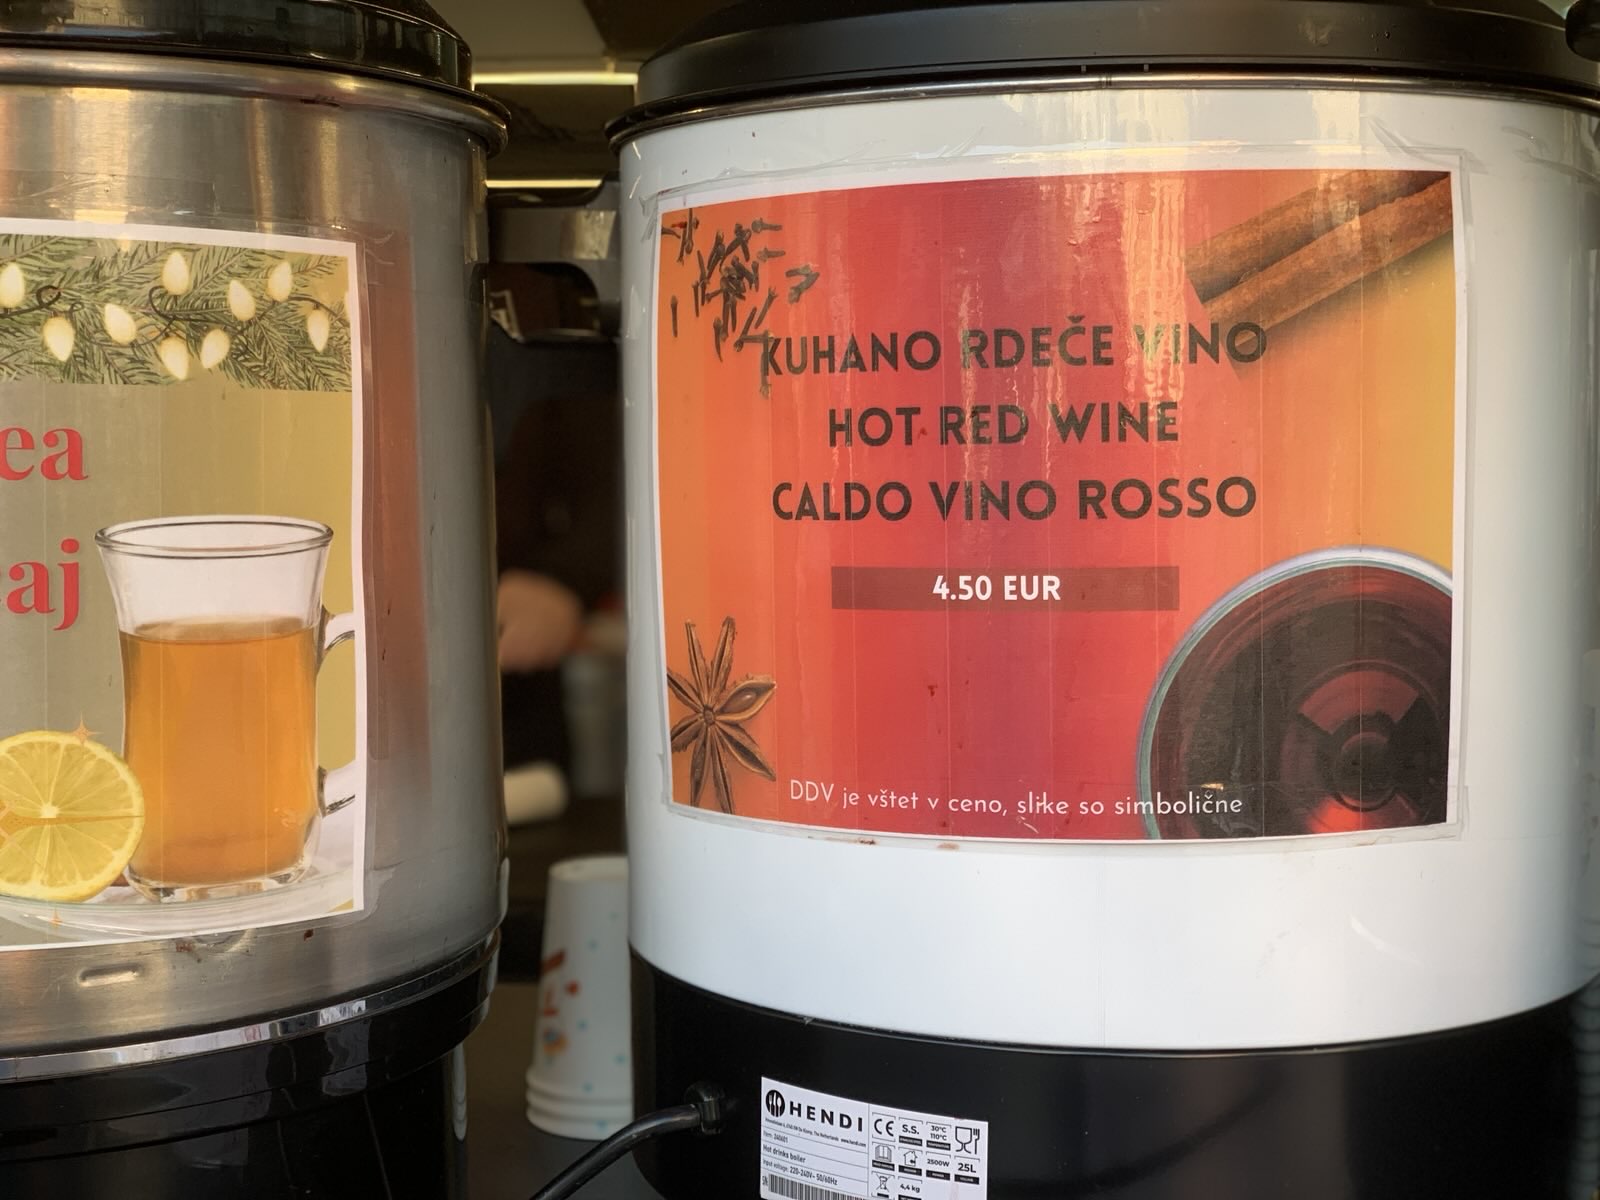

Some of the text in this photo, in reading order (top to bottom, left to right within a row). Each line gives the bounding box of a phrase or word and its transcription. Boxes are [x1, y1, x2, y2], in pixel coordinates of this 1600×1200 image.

[764, 315, 1267, 377] KUHANO RDEČE VINO
[828, 401, 1179, 447] HOT RED WINE
[772, 476, 1257, 522] CALDO VINO ROSSO
[0, 538, 80, 631] aj
[932, 575, 1061, 601] 4.50 EUR
[790, 779, 1243, 817] DDV je vštet v ceno, slike so simbolične
[789, 1101, 863, 1132] HENDI
[902, 1124, 920, 1135] S.S.
[772, 1146, 789, 1159] drinks
[789, 1152, 806, 1163] boiler
[927, 1158, 950, 1167] 2500W
[957, 1162, 977, 1173] 25L
